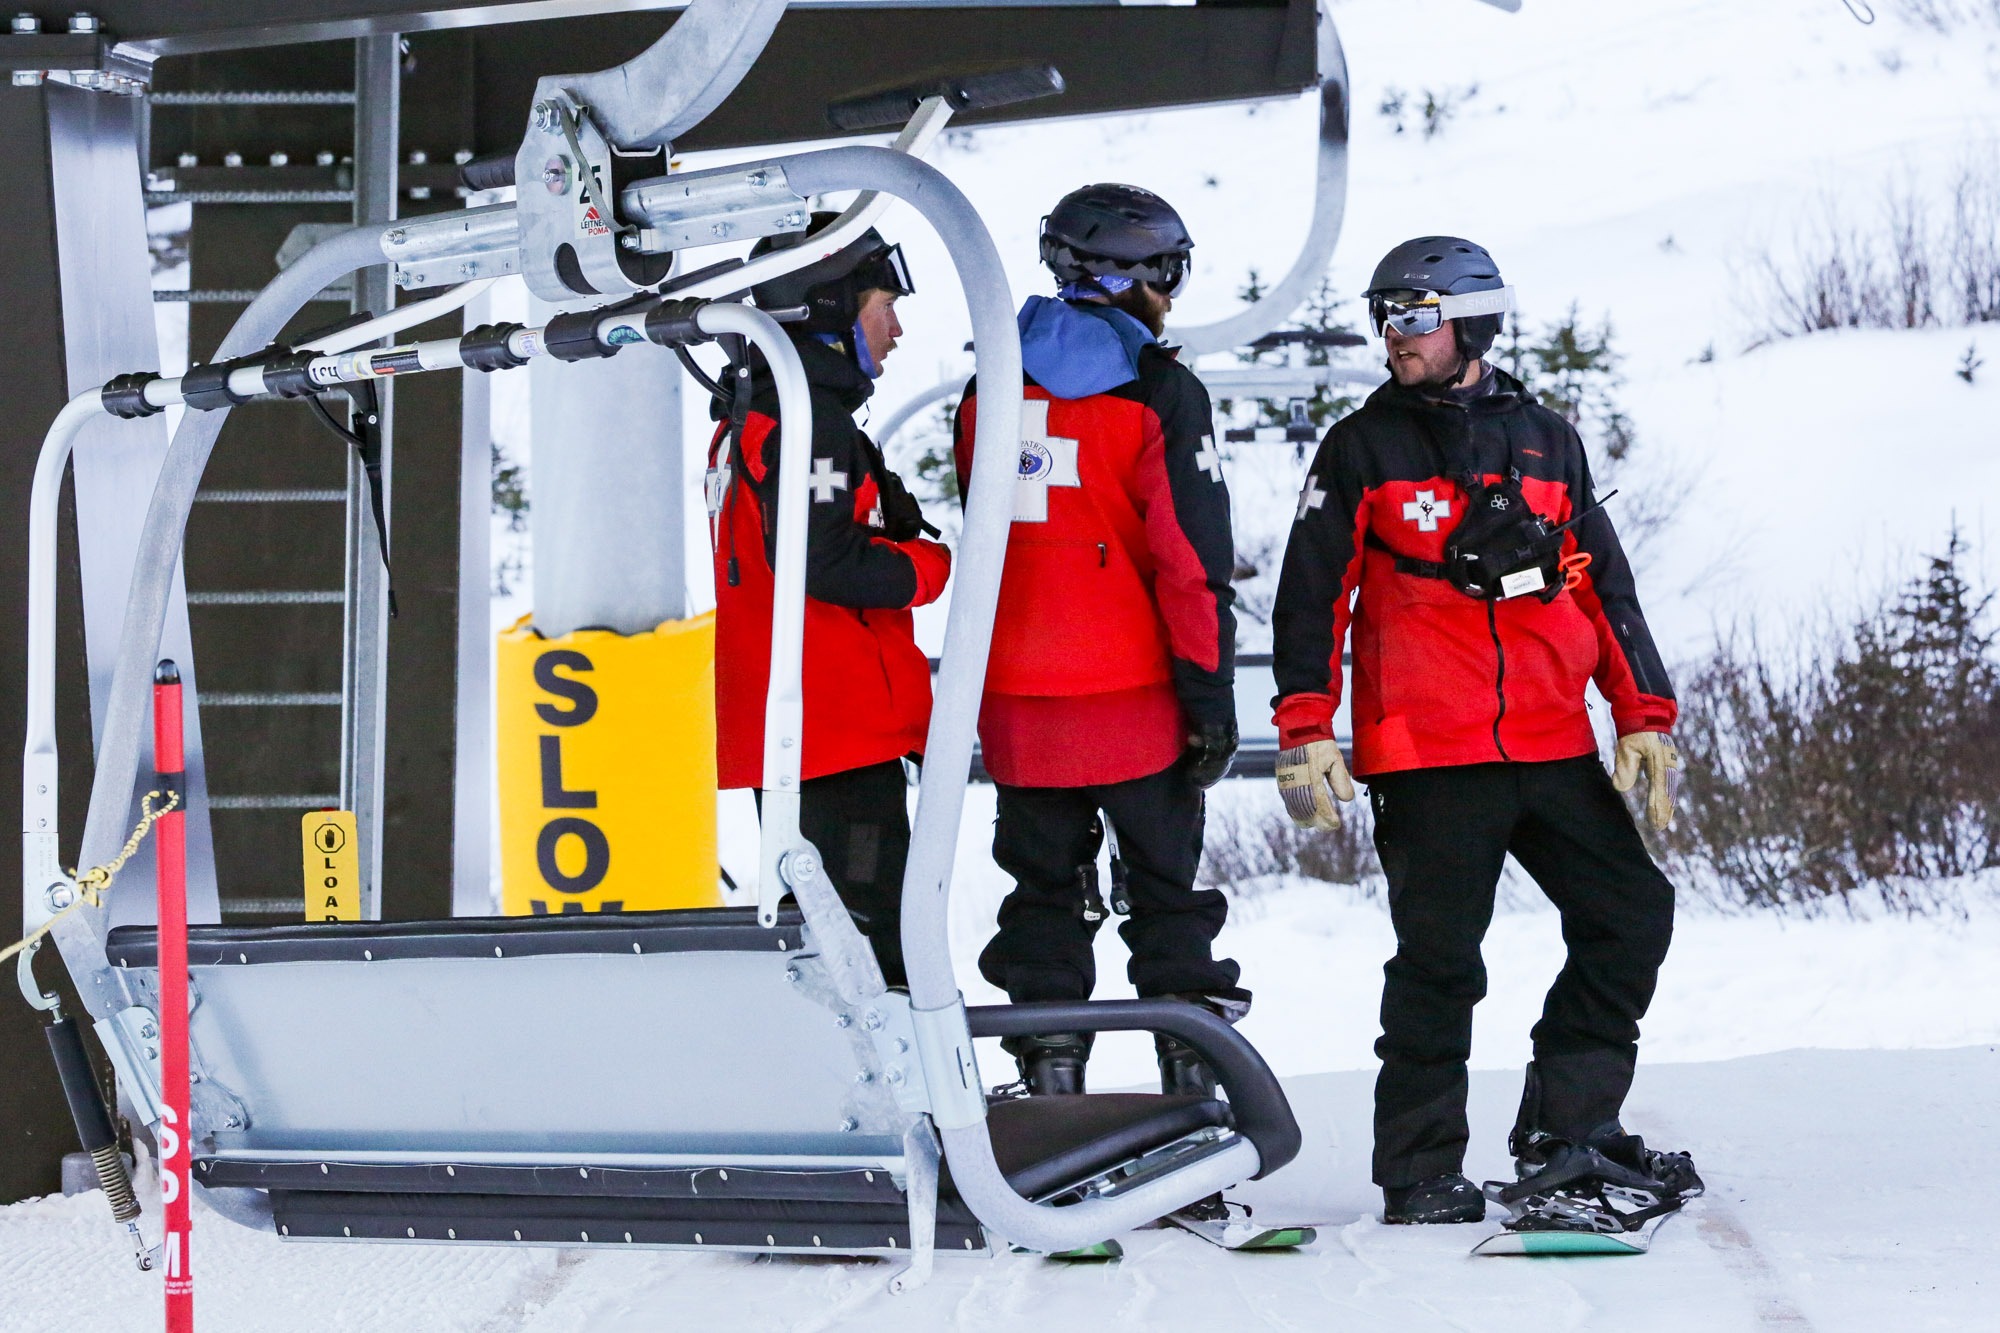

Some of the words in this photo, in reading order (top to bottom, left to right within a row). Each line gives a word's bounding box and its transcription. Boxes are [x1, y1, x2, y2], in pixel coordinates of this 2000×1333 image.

[580, 219, 606, 230] LEITNE
[588, 226, 609, 236] POMA
[1465, 296, 1503, 311] SMITH
[1020, 440, 1047, 457] PATROL
[530, 649, 624, 915] SLO
